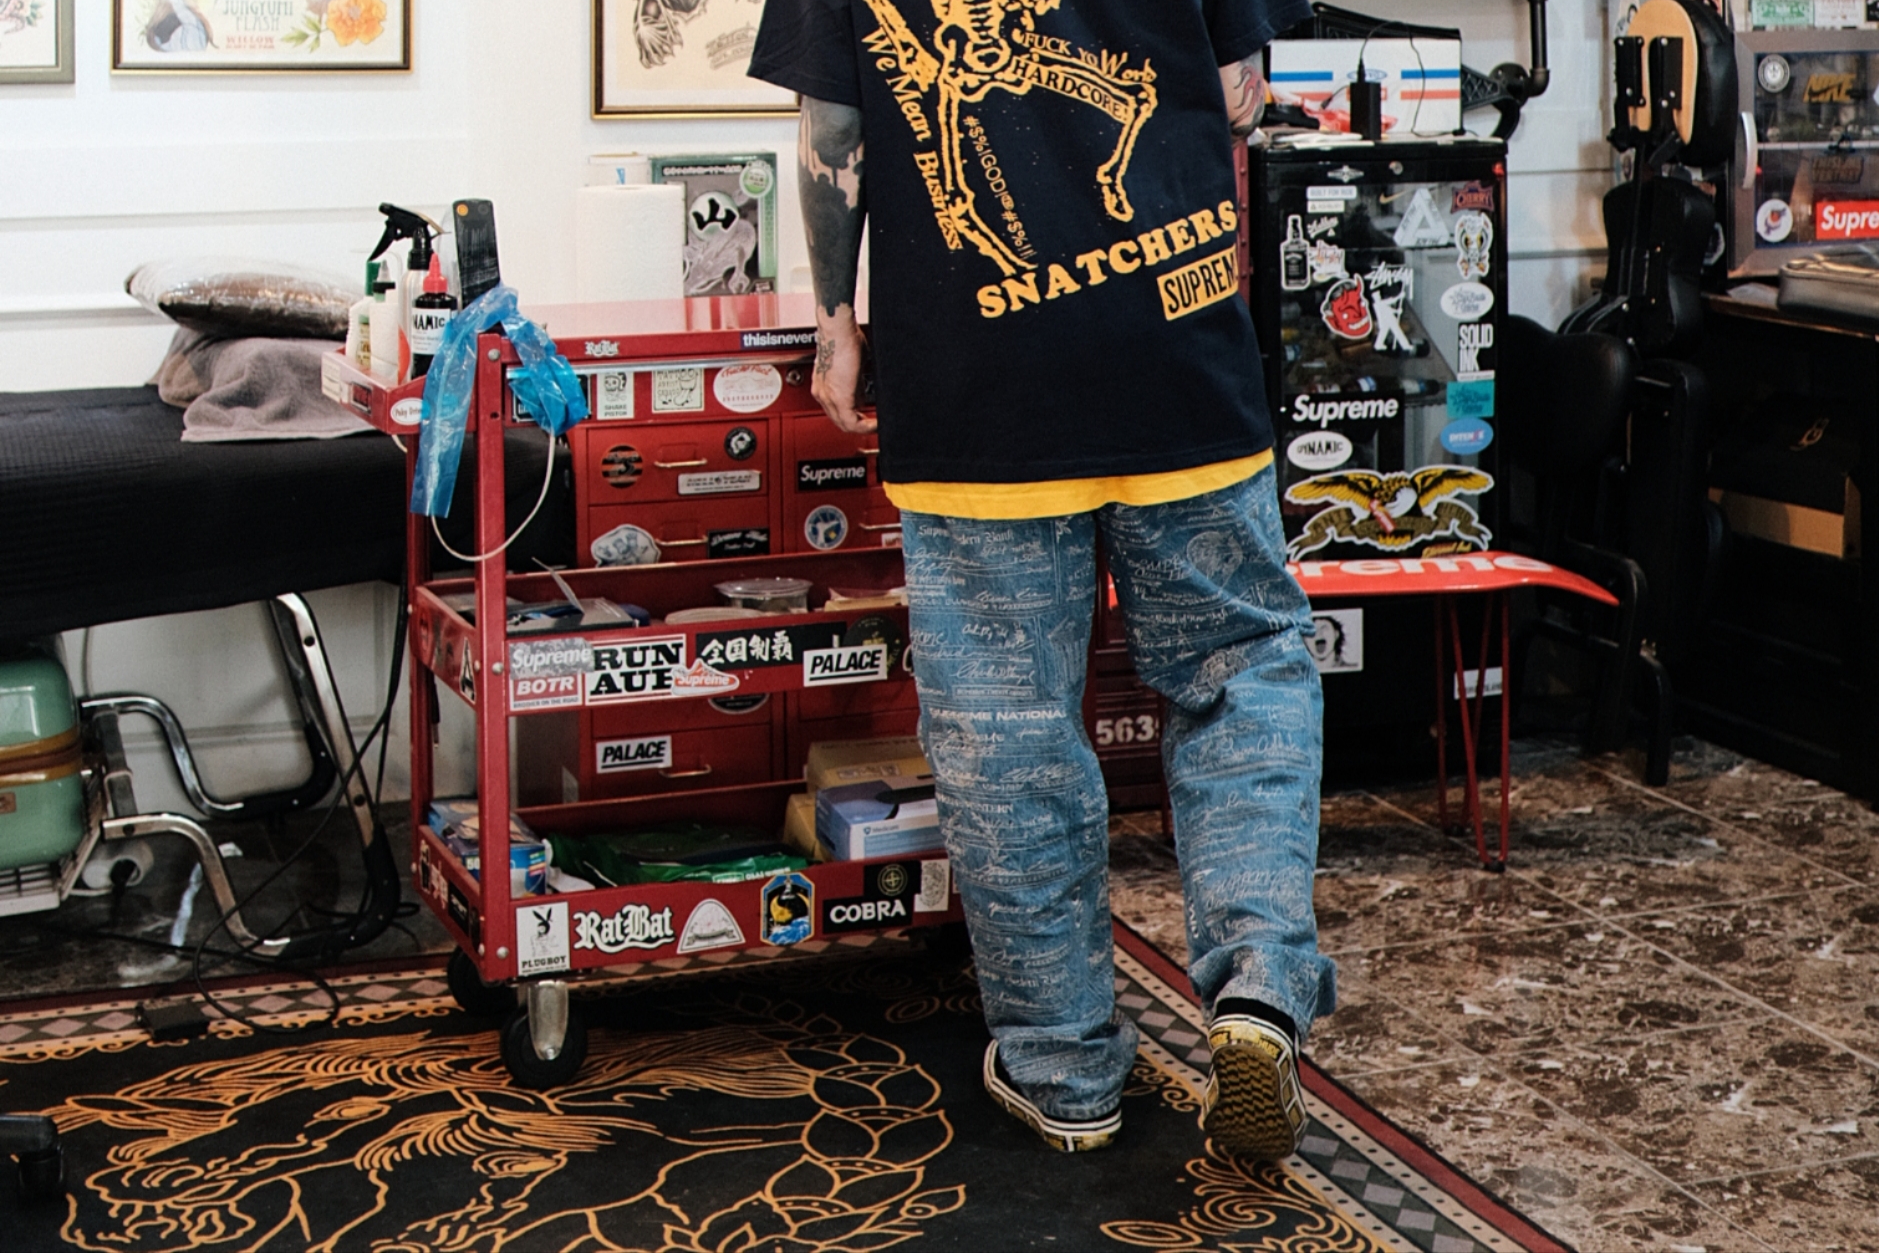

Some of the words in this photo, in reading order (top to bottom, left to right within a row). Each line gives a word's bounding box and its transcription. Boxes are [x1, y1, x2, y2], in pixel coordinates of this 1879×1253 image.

[235, 16, 280, 32] FLASH
[862, 25, 898, 72] We
[1023, 32, 1071, 56] FUCK
[1010, 58, 1134, 125] HARDCORE!
[1803, 72, 1857, 104] NIKE
[885, 73, 934, 142] Mean
[912, 150, 963, 251] Business
[1456, 194, 1490, 208] CHERRY
[976, 199, 1240, 319] SNATCHERS
[1459, 324, 1494, 349] SOLID
[1459, 348, 1481, 373] INK
[1292, 394, 1399, 429] Supreme
[1297, 440, 1344, 456] DYNAMIC
[800, 464, 866, 483] Supreme
[512, 647, 592, 672] Supreme
[594, 642, 684, 671] RUN
[810, 649, 884, 675] PALACE
[517, 676, 575, 695] BOTR
[676, 675, 730, 687] Supreme
[602, 740, 668, 764] PALACE
[830, 899, 907, 924] COBRA
[573, 904, 675, 954] RatBat
[522, 955, 567, 969] PLUGBOY
